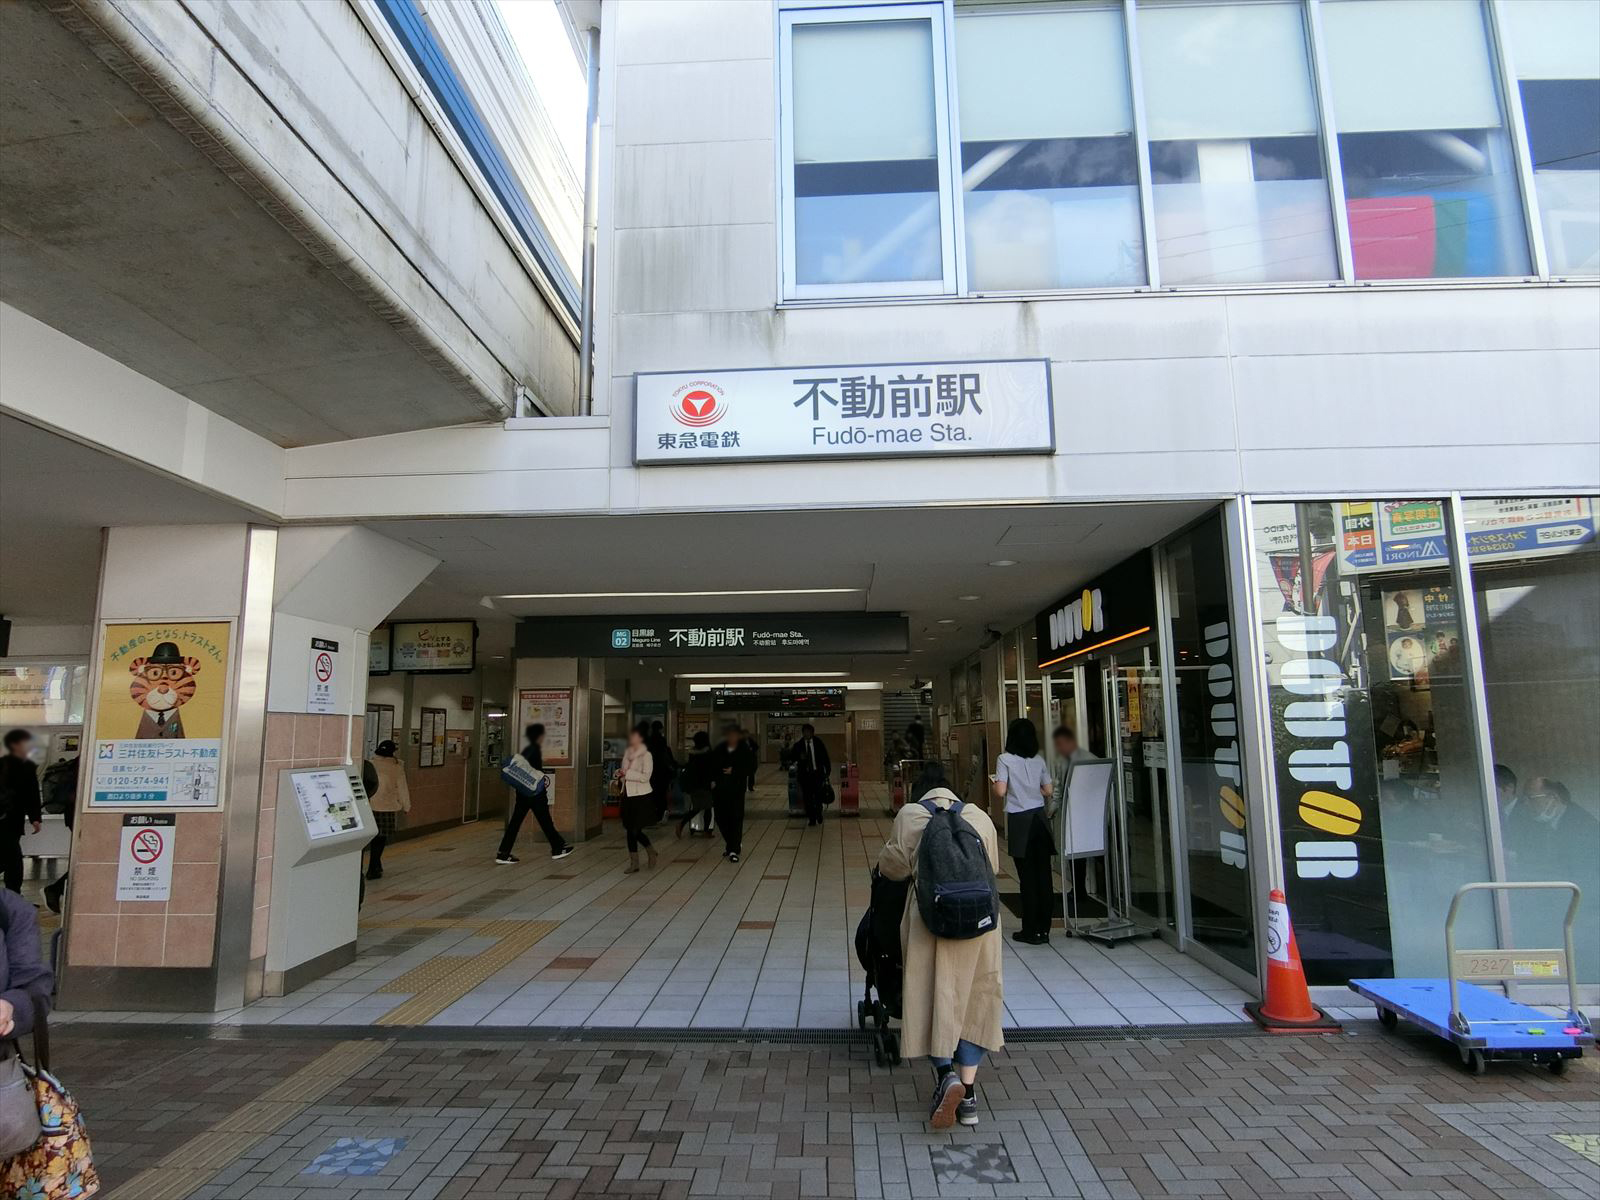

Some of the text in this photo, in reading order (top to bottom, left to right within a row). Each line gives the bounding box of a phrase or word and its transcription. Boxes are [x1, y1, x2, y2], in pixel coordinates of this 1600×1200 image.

[672, 380, 725, 398] TOKYU CORPORATION
[793, 373, 983, 421] 不動前駅
[657, 431, 741, 449] 東急電鉄
[812, 423, 972, 445] Fudō-mae Sta.
[615, 638, 627, 646] 02
[669, 628, 745, 648] 不動前駅
[119, 748, 218, 759] 三井住友トラスト不動産
[1276, 615, 1362, 879] DOUTOR
[107, 776, 169, 785] 0120-574-941
[1471, 959, 1510, 974] 2327
